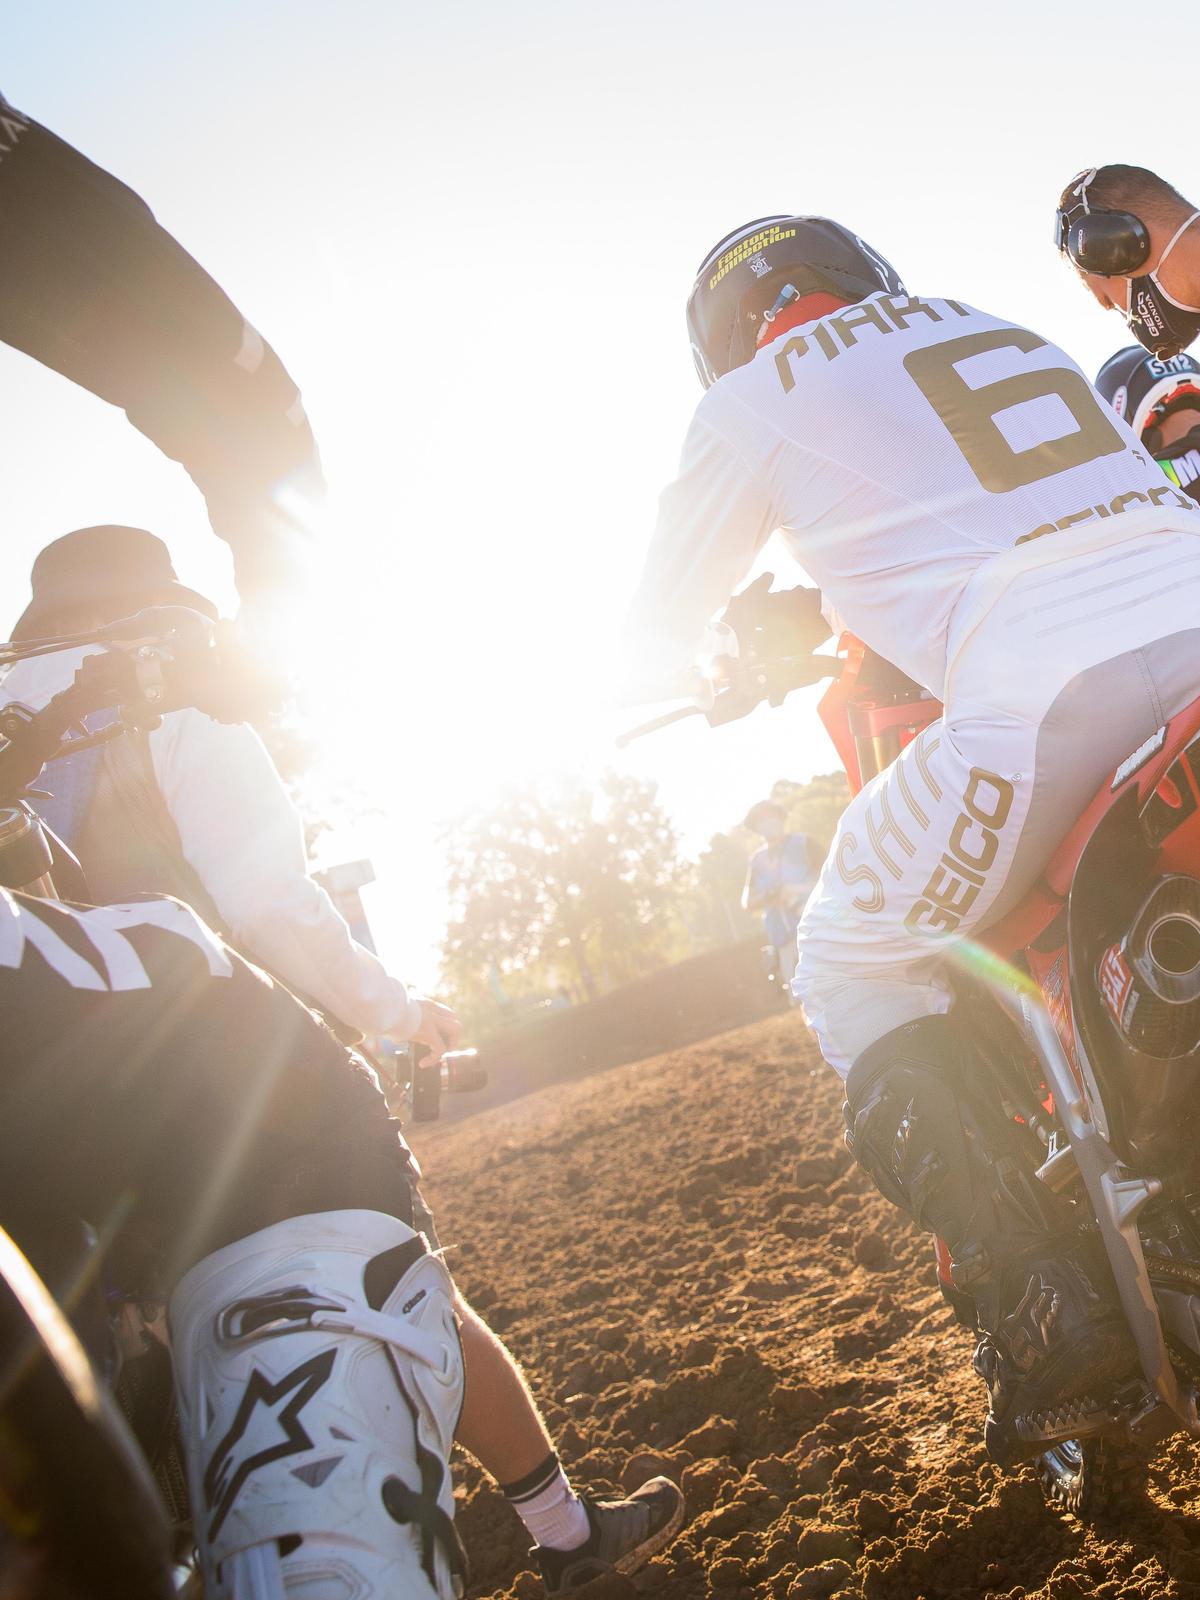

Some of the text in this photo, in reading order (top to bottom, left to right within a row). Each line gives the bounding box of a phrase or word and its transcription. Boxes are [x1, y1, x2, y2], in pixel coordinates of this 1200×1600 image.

[1137, 291, 1160, 337] GEICO
[1145, 294, 1165, 329] HONDA
[902, 328, 1127, 494] 6
[903, 766, 1014, 939] GEICO
